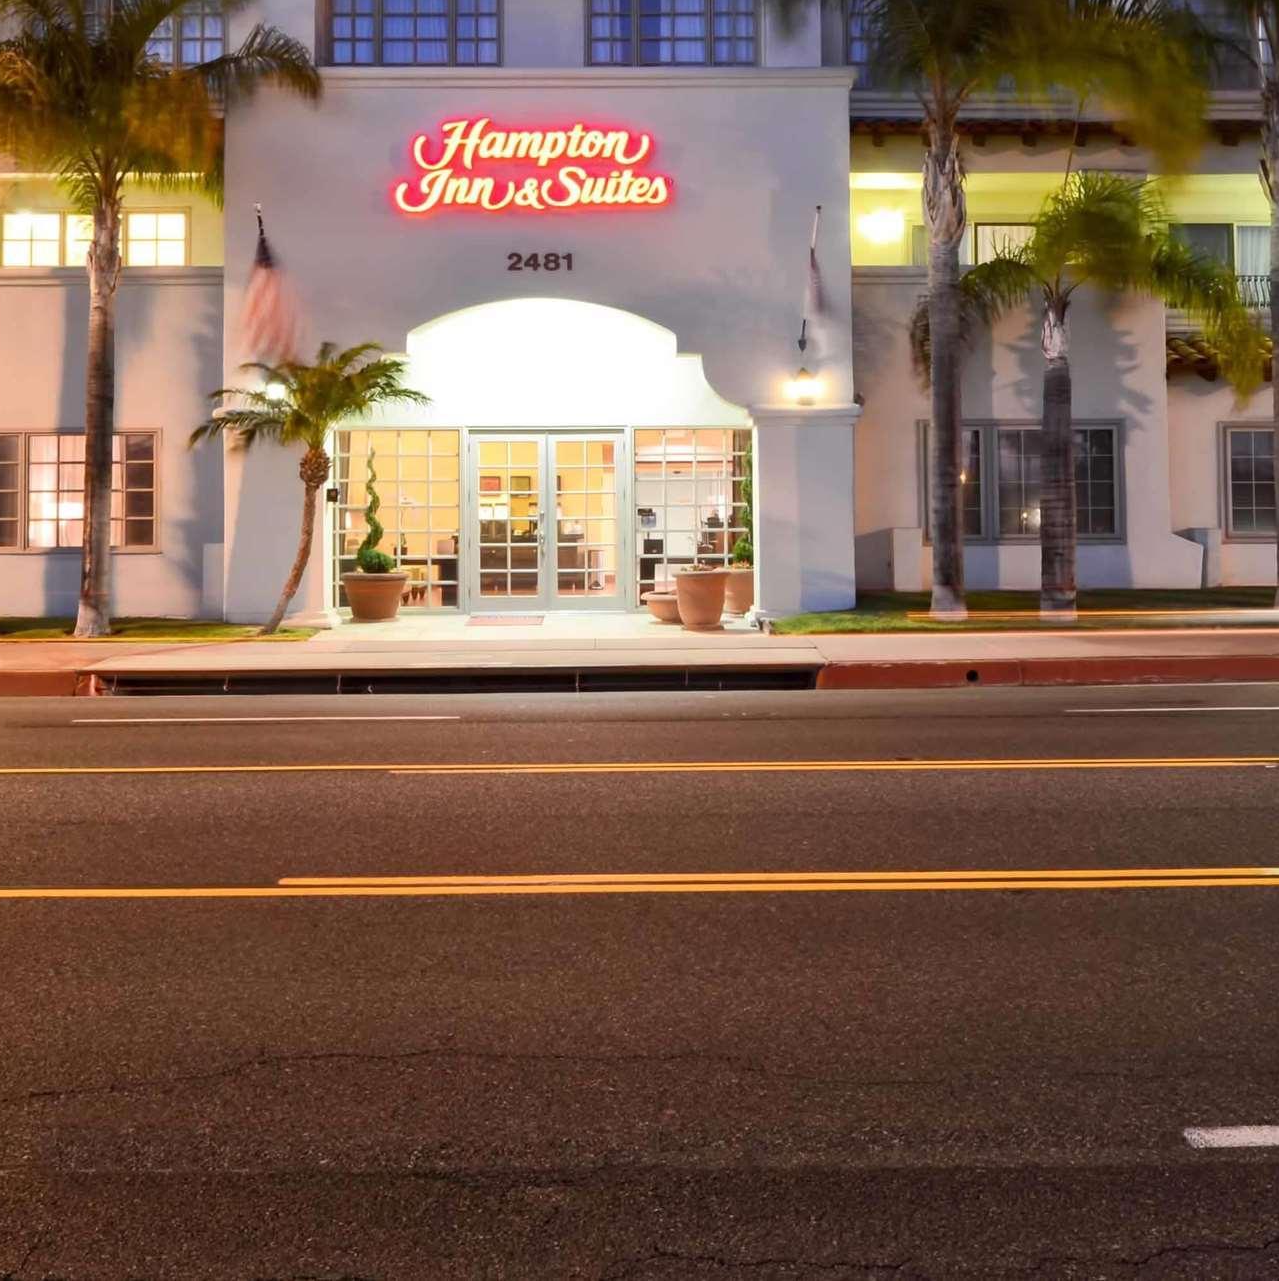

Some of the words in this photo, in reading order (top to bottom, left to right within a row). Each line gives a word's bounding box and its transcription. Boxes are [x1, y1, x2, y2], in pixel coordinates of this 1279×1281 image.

[413, 118, 650, 170] Hampton
[395, 169, 515, 212] Inn
[514, 178, 546, 209] &
[541, 166, 668, 207] Suites
[507, 253, 574, 271] 2481
